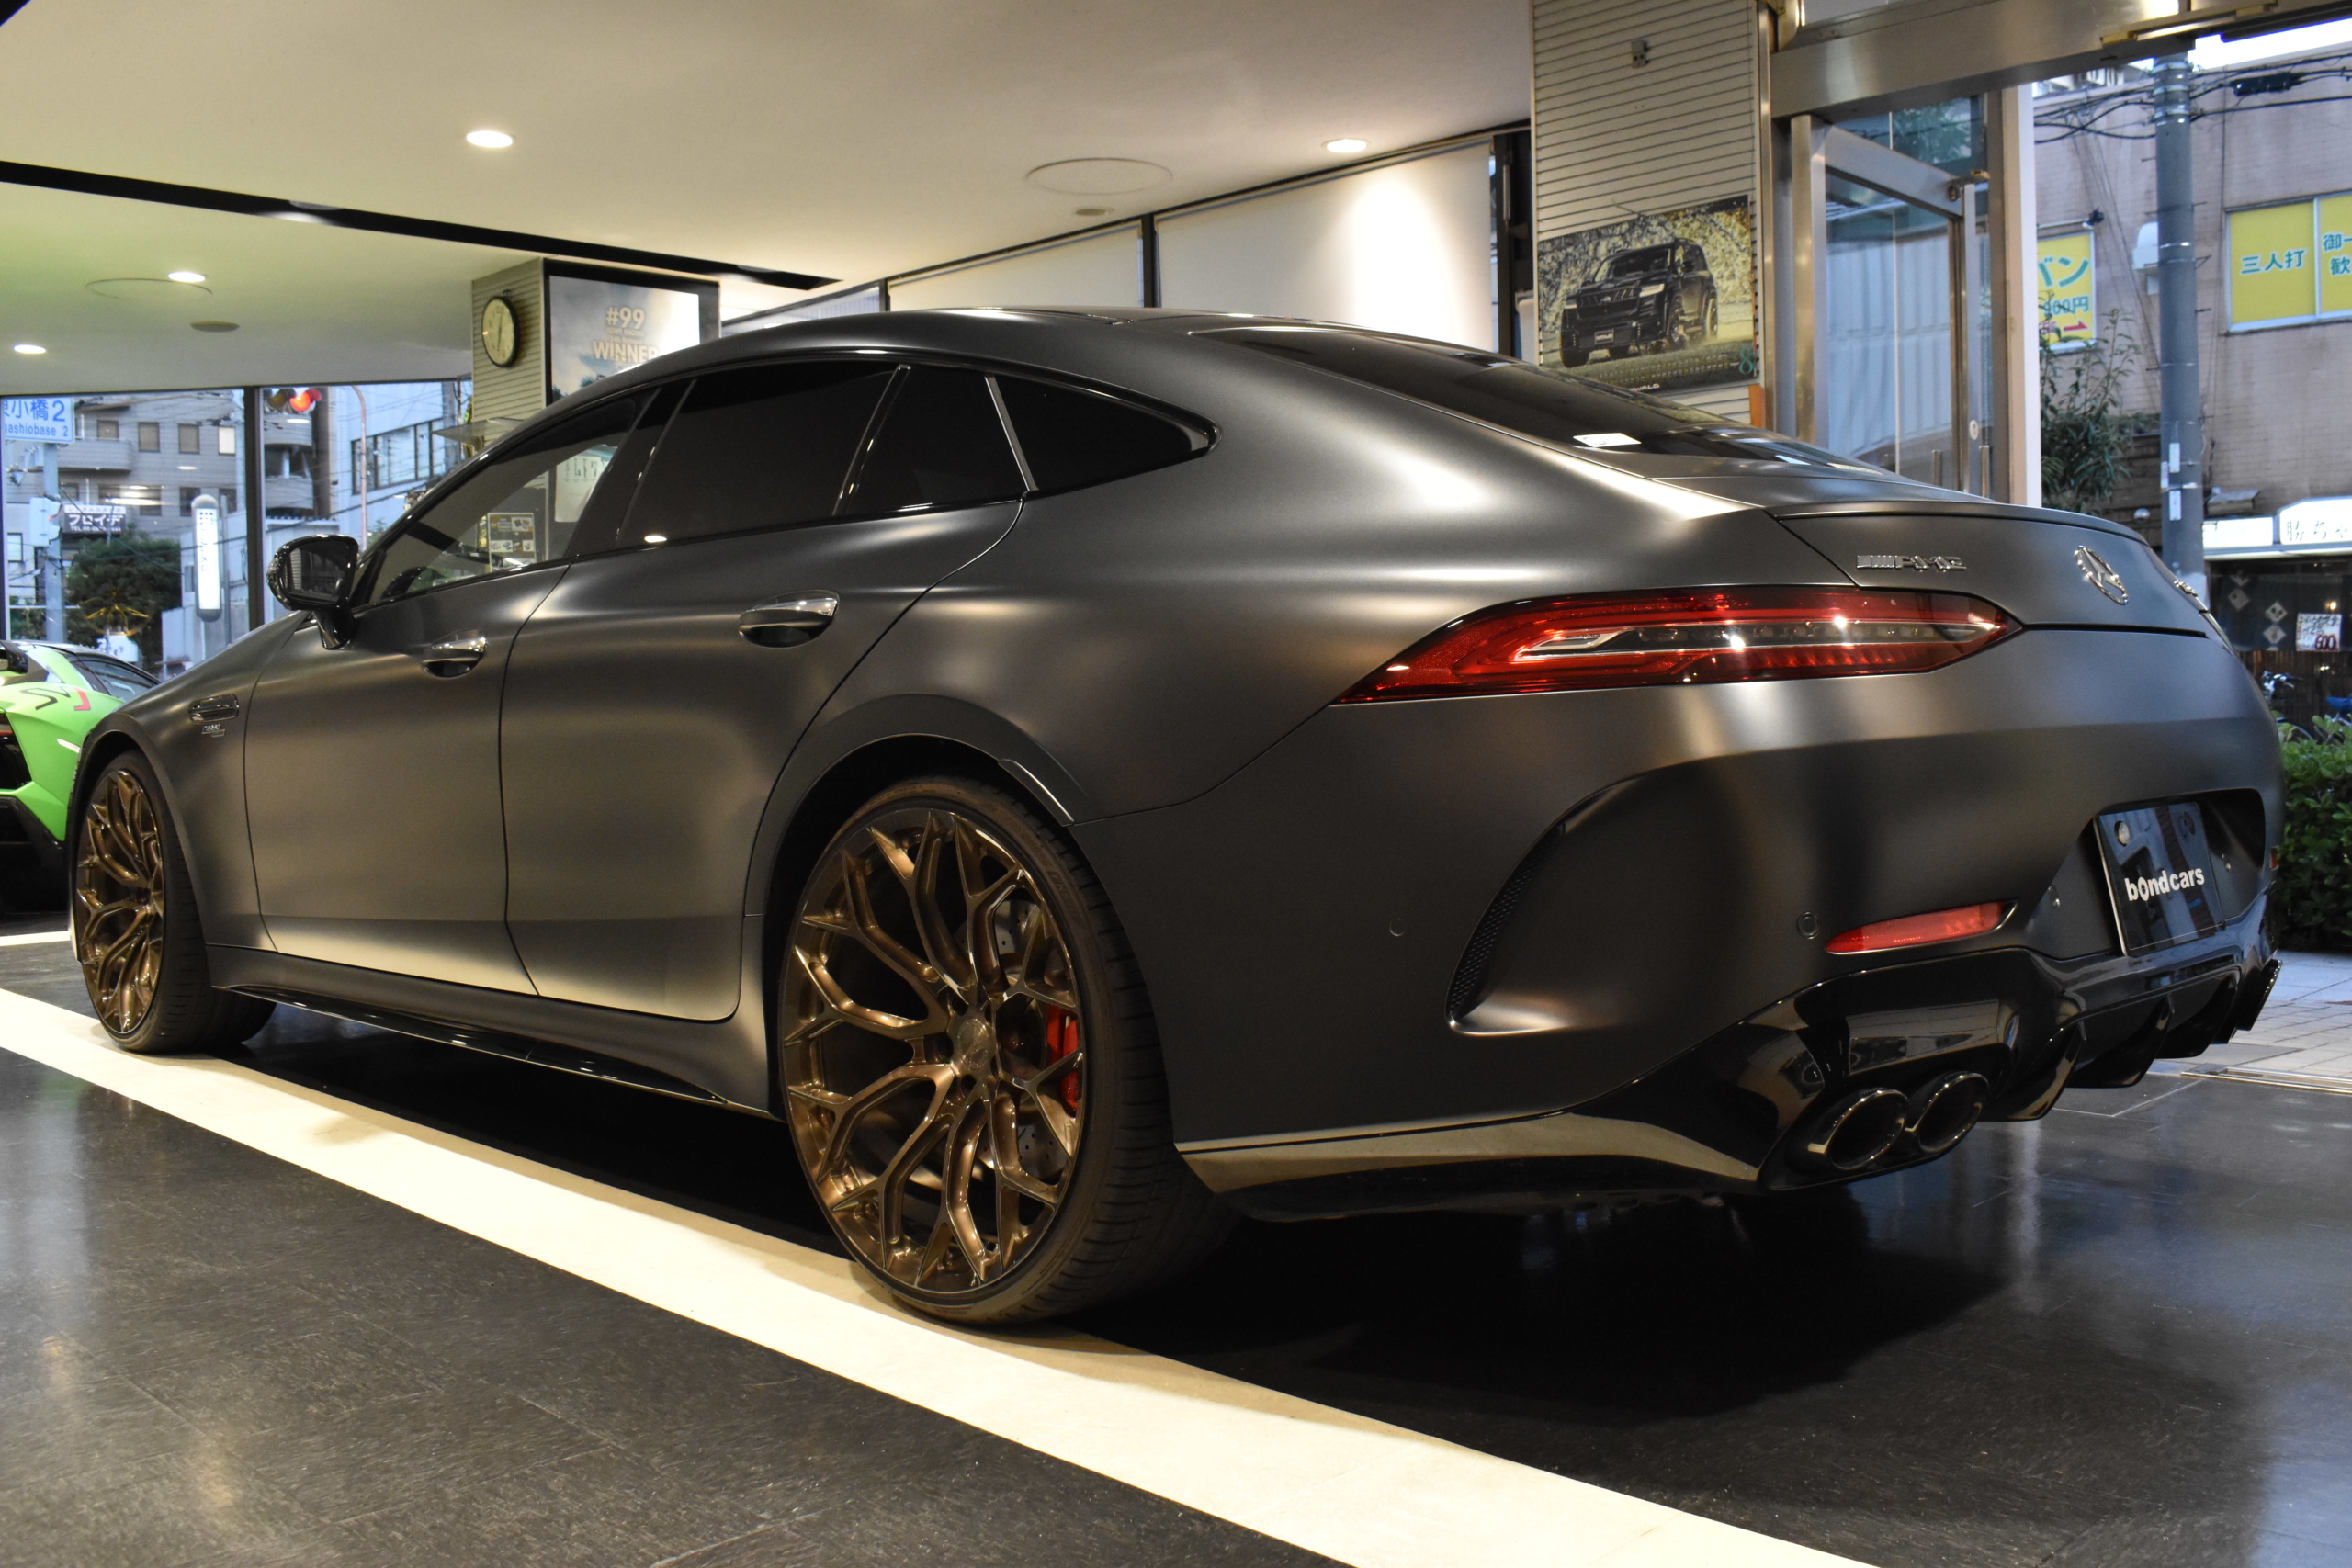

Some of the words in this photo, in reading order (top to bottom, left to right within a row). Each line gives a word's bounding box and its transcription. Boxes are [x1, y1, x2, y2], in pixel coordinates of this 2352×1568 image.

[2240, 250, 2305, 275] 三人打
[606, 307, 645, 329] #99
[62, 425, 68, 437] 2
[2124, 868, 2205, 901] bondcars
